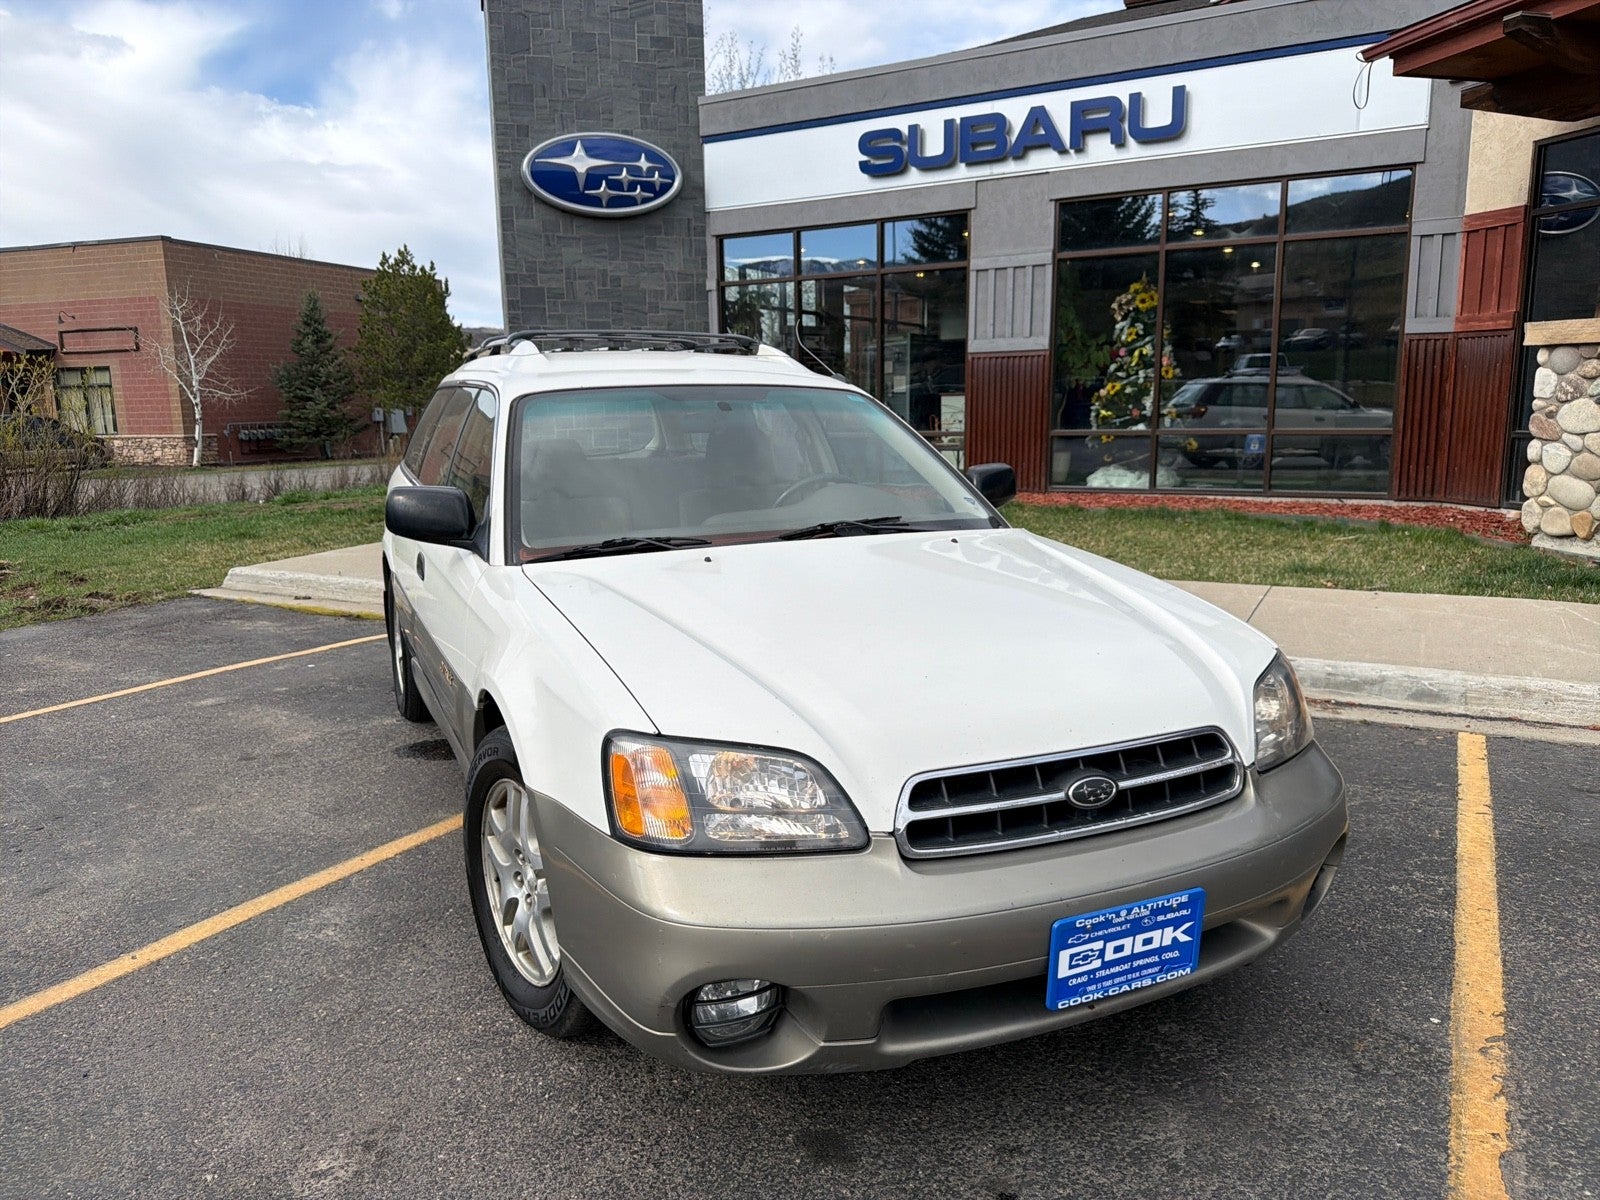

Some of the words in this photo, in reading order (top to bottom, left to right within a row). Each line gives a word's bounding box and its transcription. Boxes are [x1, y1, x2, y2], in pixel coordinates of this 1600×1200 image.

[858, 84, 1187, 176] SUBARU
[1075, 913, 1116, 928] Cook'n
[1119, 909, 1128, 919] @
[1131, 894, 1189, 915] ALTITUDE
[1156, 908, 1191, 922] SUBARU
[1090, 923, 1132, 938] CHEVROLET
[1057, 921, 1195, 979] COOK
[1057, 967, 1191, 1010] COOK-CARS.COM
[1068, 974, 1088, 986] CRAIG
[1095, 962, 1131, 979] STEAMBOAT
